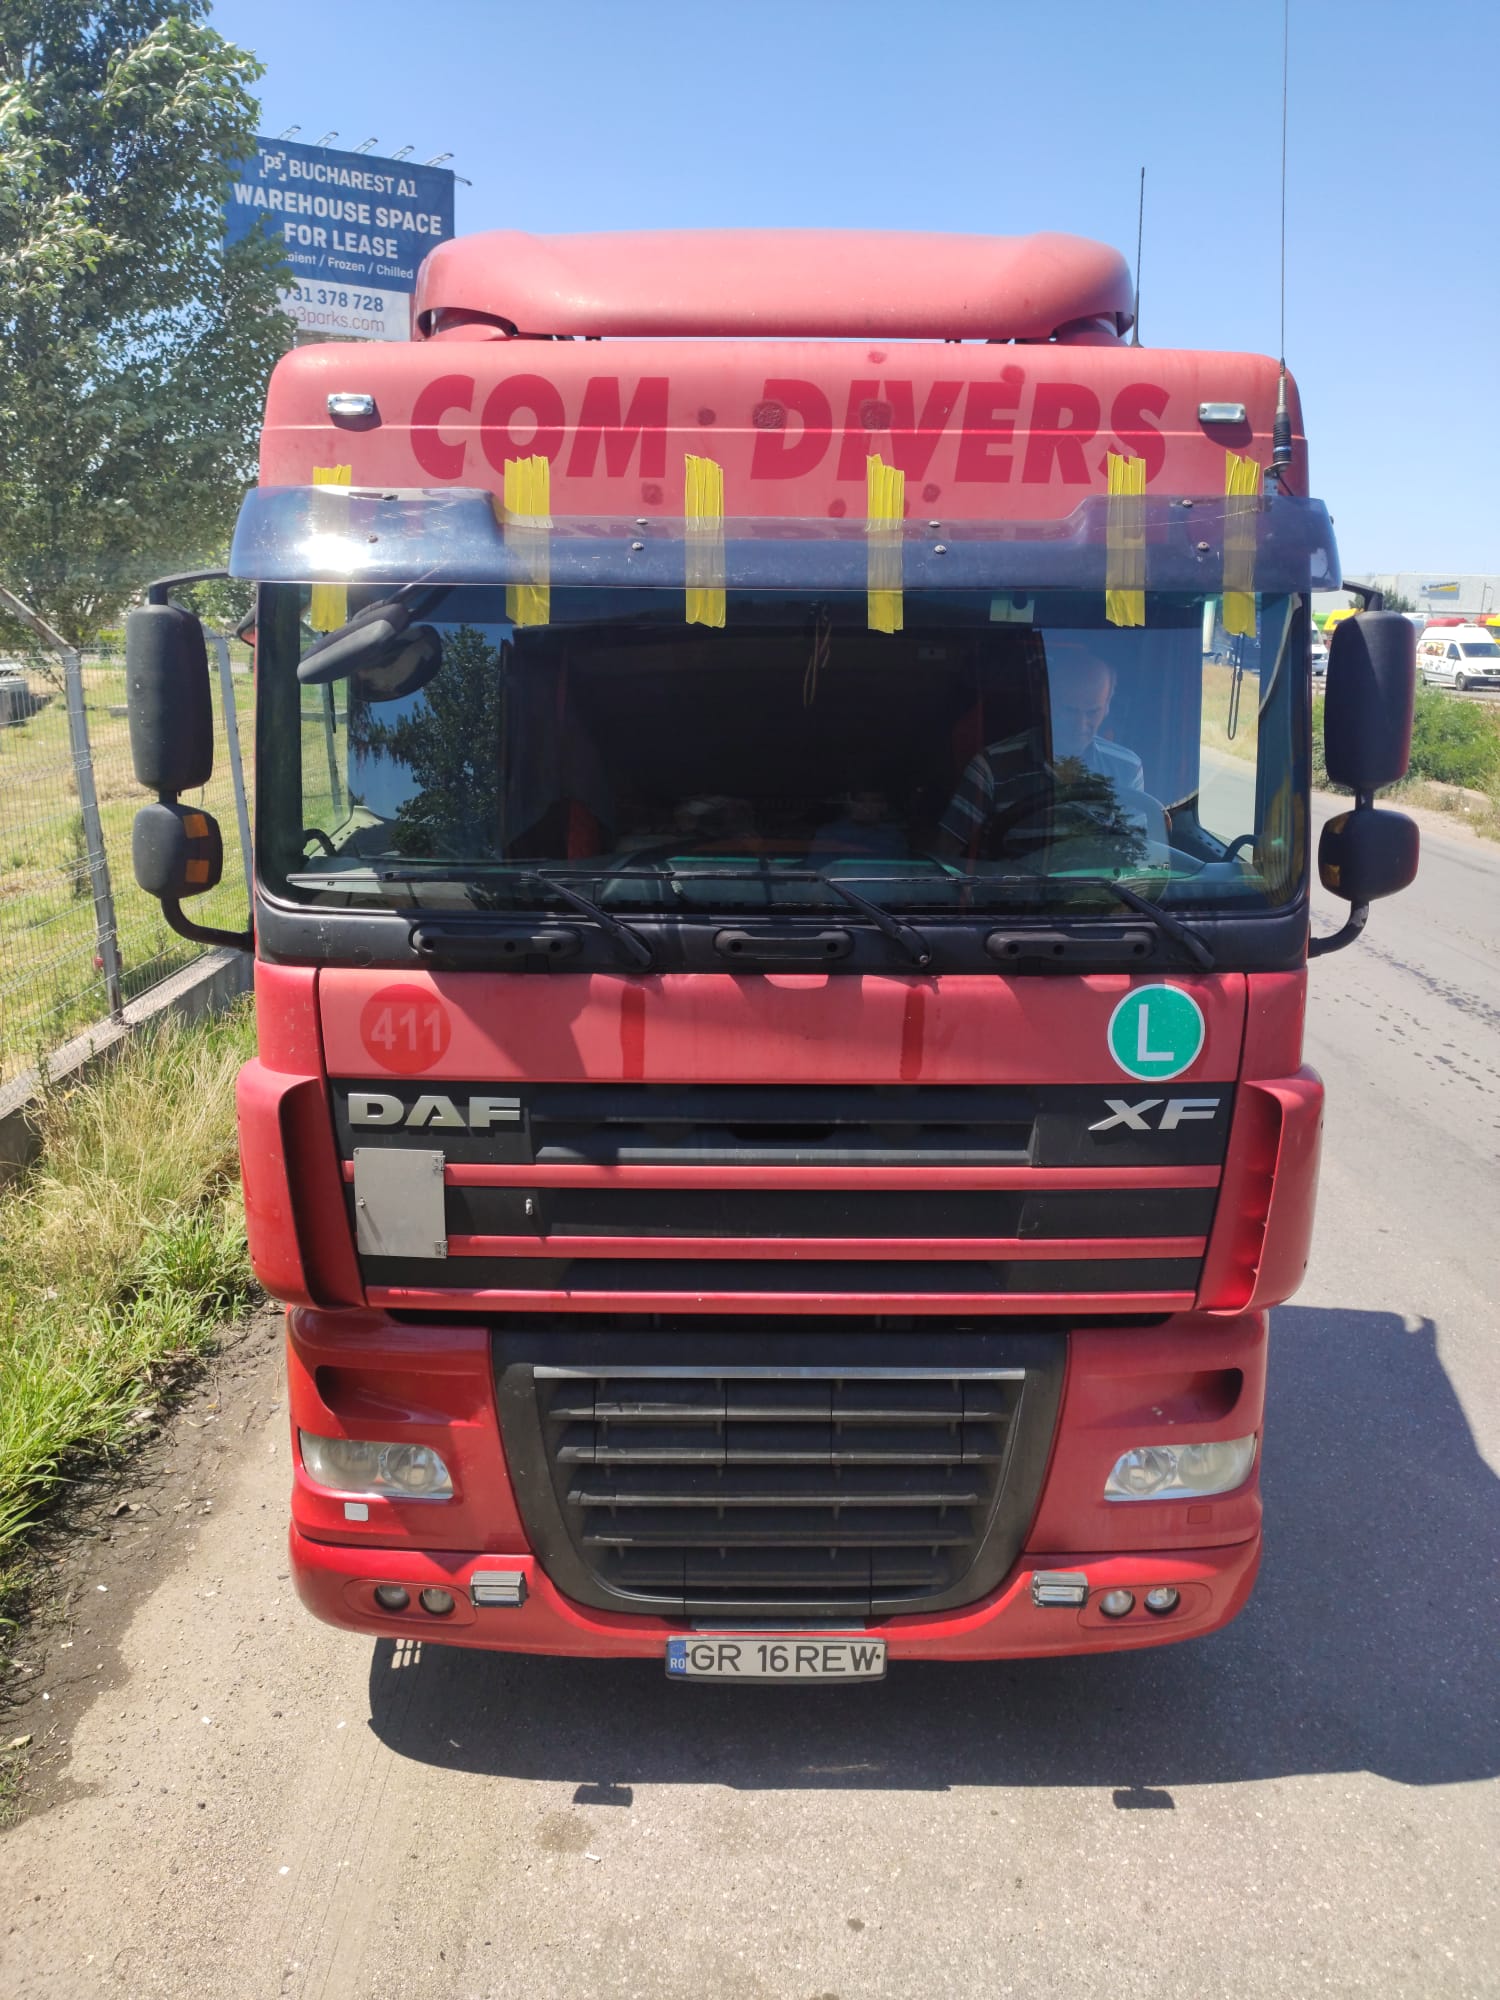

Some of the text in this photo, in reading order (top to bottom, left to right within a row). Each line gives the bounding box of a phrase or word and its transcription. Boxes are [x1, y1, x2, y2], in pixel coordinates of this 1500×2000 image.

[289, 159, 394, 195] BUCHAREST
[397, 180, 418, 198] A1
[233, 183, 442, 236] WAREHOUSE SPACE
[284, 222, 399, 259] FOR LEASE
[280, 251, 316, 265] bient
[328, 257, 365, 273] Frozen
[376, 264, 414, 279] Chilled
[317, 288, 348, 308] 378
[353, 294, 384, 312] 728
[410, 374, 1172, 486] COM DIVERS
[370, 1007, 441, 1052] 411
[1137, 1003, 1174, 1062] L
[348, 1092, 521, 1128] DAF
[1088, 1098, 1220, 1131] XF
[670, 1657, 685, 1669] RO
[690, 1644, 742, 1672] GR
